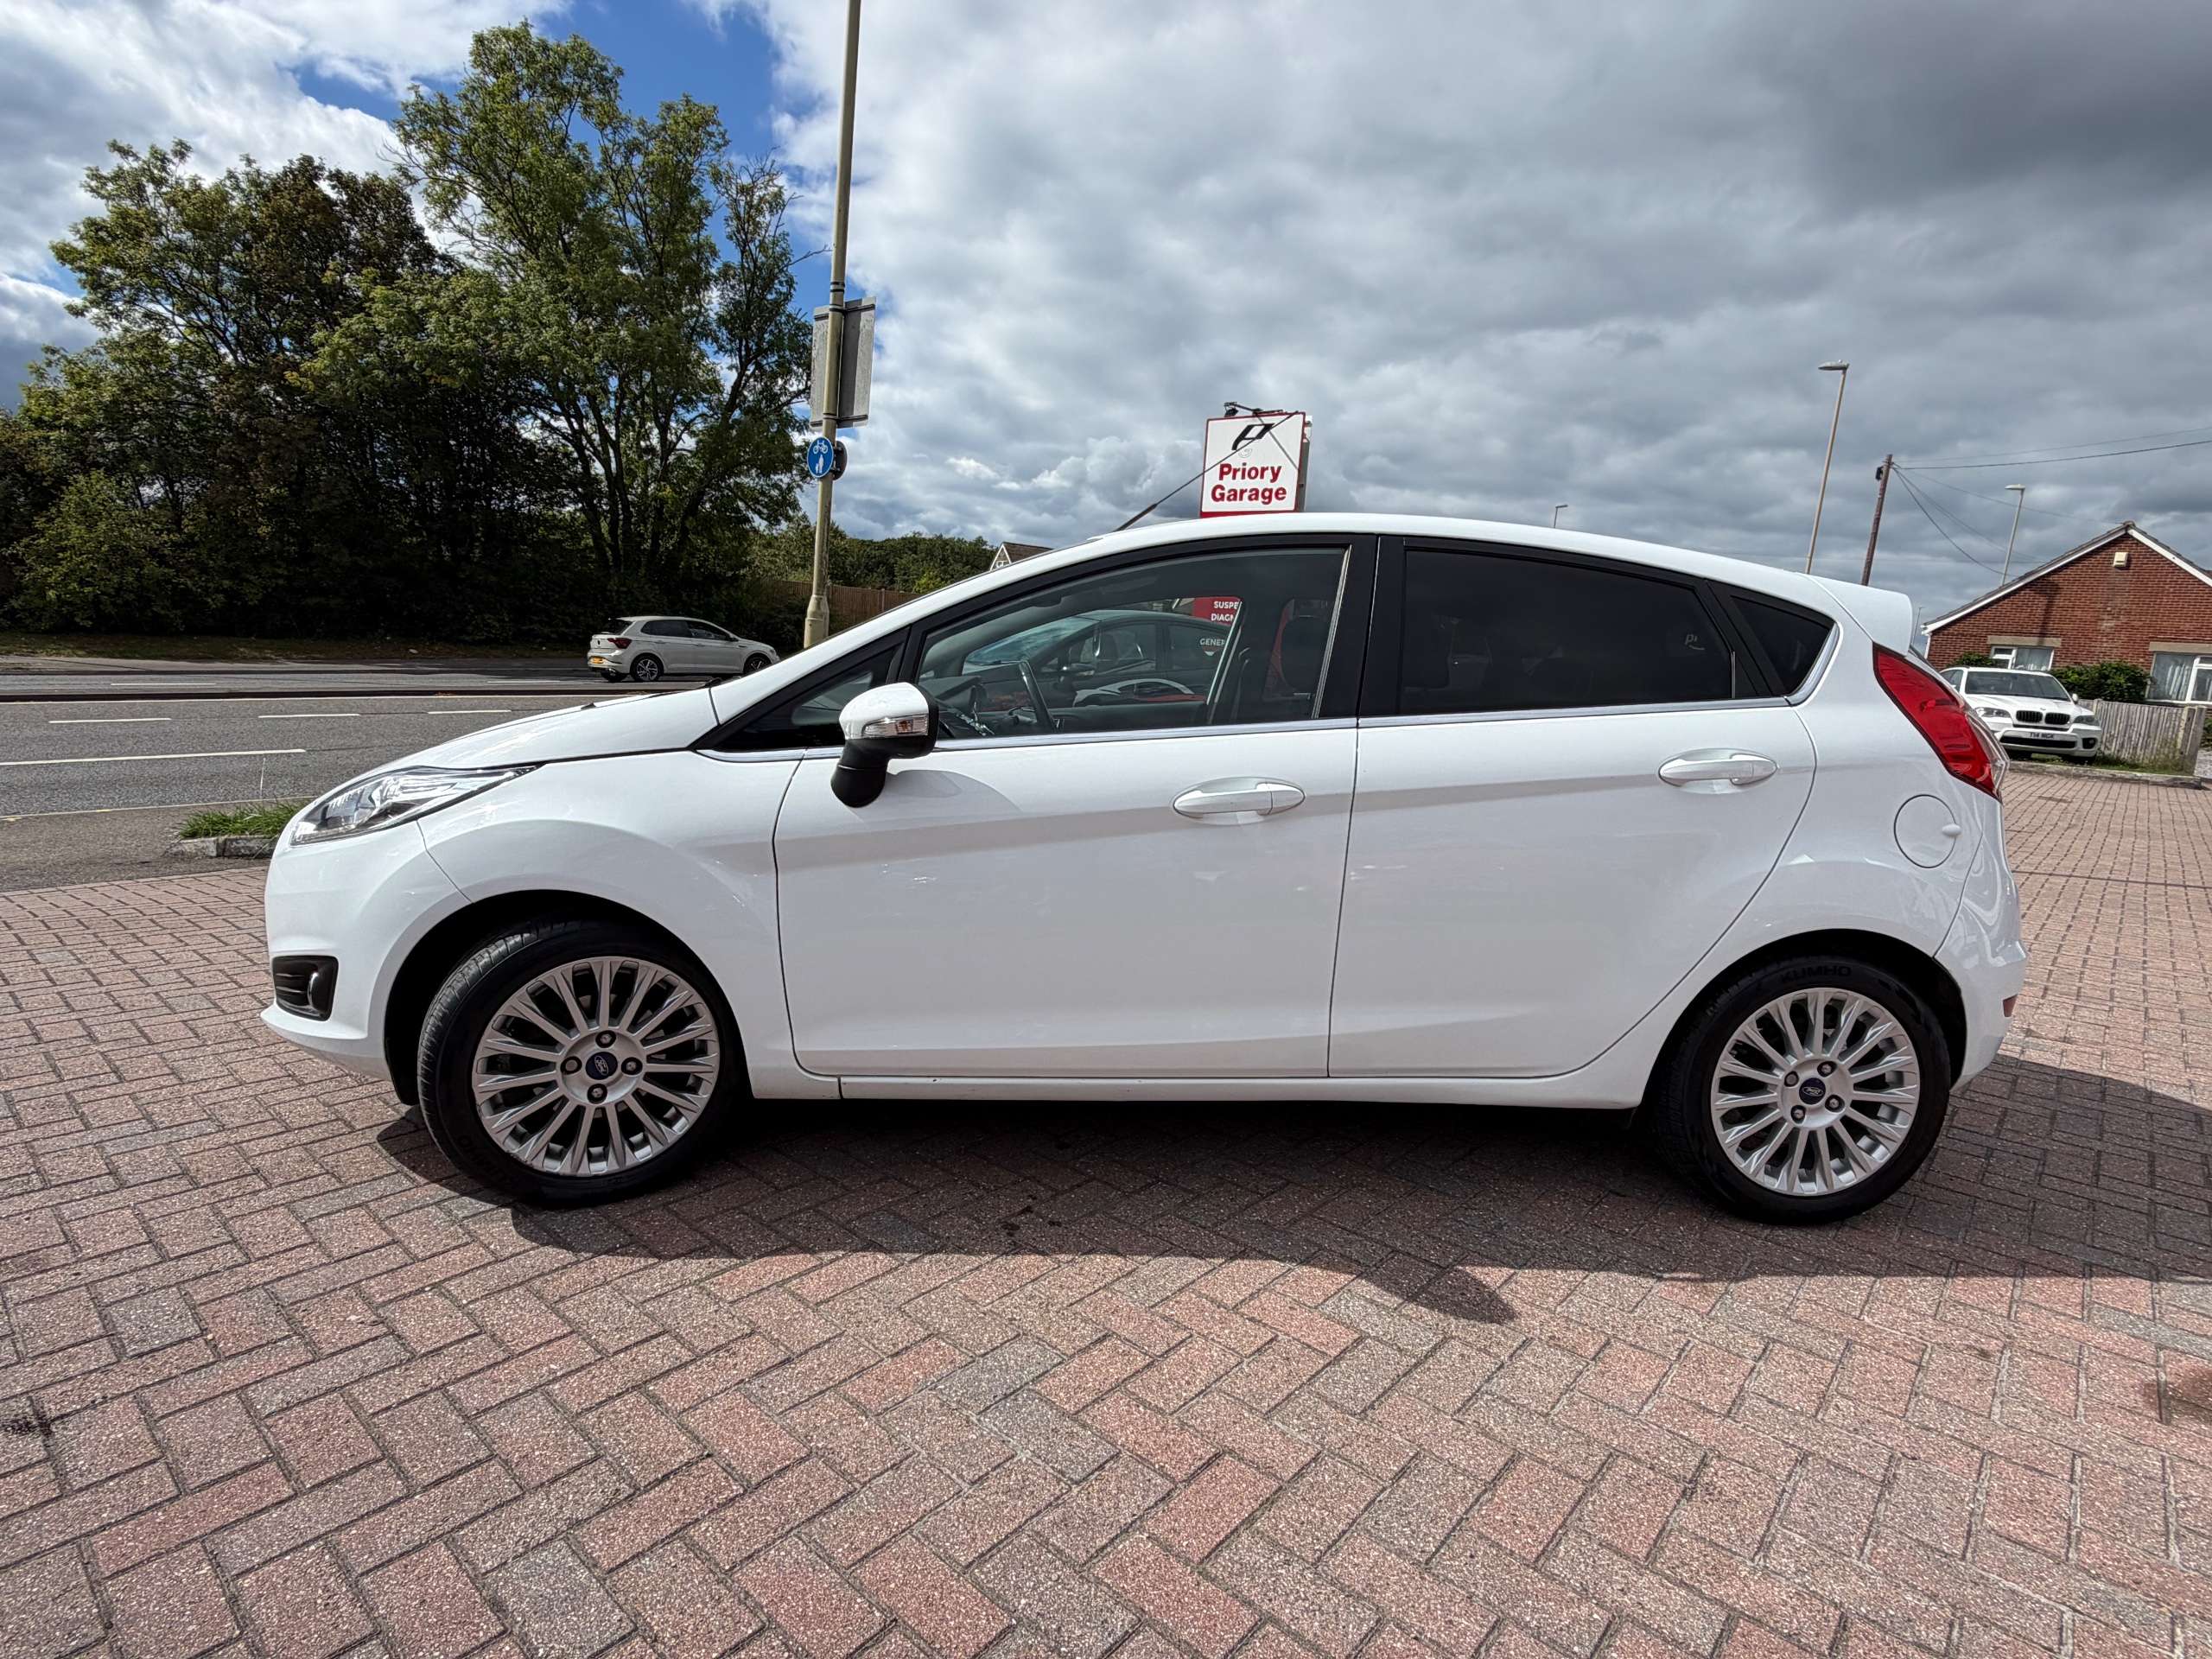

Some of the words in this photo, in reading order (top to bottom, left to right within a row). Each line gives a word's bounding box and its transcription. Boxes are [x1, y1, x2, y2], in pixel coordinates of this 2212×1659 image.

[1219, 462, 1282, 483] Priory
[1211, 485, 1287, 505] Garage
[1213, 601, 1239, 610] SUSPE
